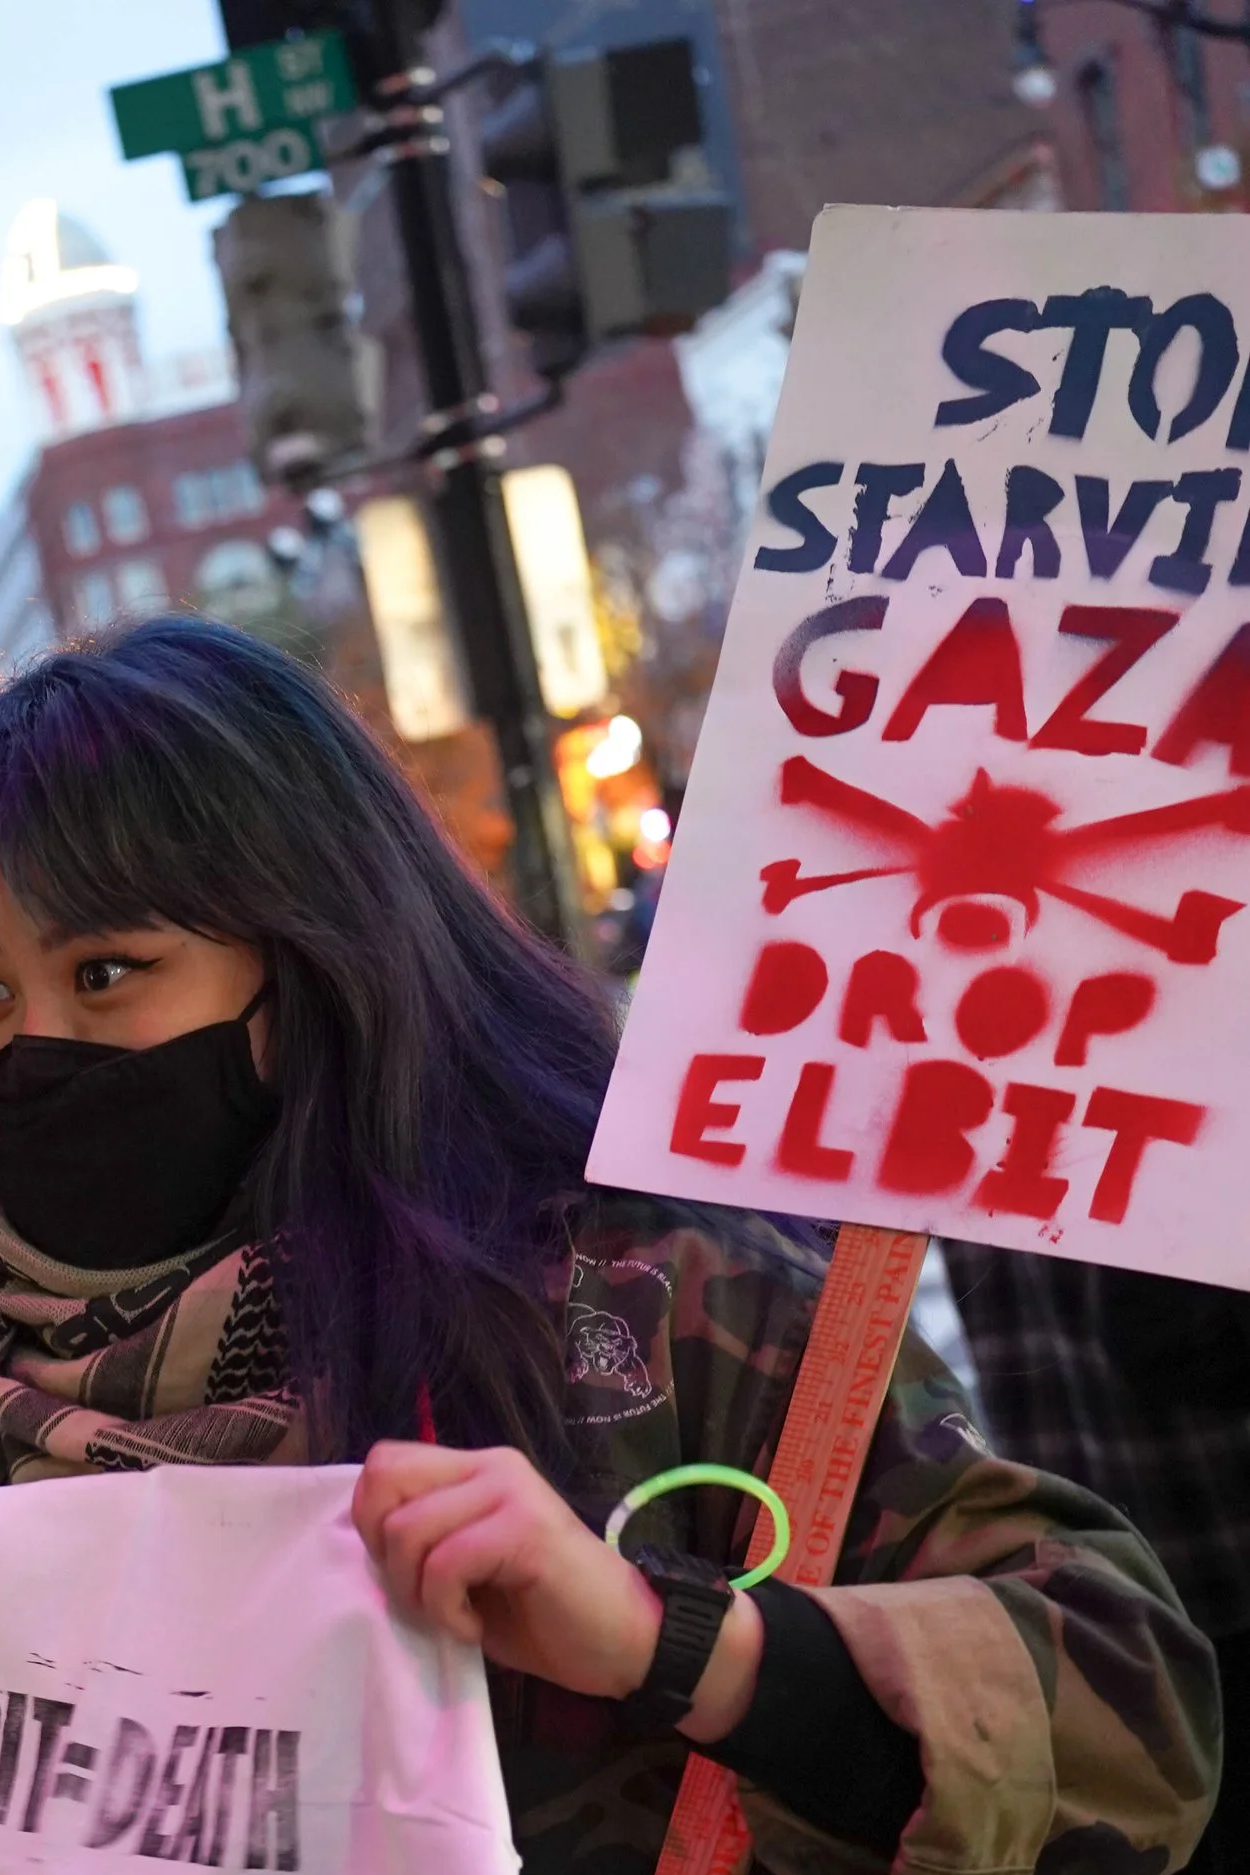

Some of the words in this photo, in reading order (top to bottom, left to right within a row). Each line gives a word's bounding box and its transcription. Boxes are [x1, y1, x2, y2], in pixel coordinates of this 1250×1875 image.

[186, 129, 310, 195] 700
[192, 59, 262, 141] H
[754, 459, 1250, 594] STARVI
[739, 940, 1156, 1066] DROP
[669, 1053, 1208, 1224] ELBIT
[575, 1253, 596, 1266] NOW
[805, 1509, 835, 1556] OF
[820, 1436, 859, 1500] THE
[842, 1310, 894, 1428] FINEST
[877, 1232, 918, 1305] PAIN
[815, 1402, 833, 1424] 21
[848, 1282, 865, 1307] 23
[586, 1415, 611, 1424] NOW
